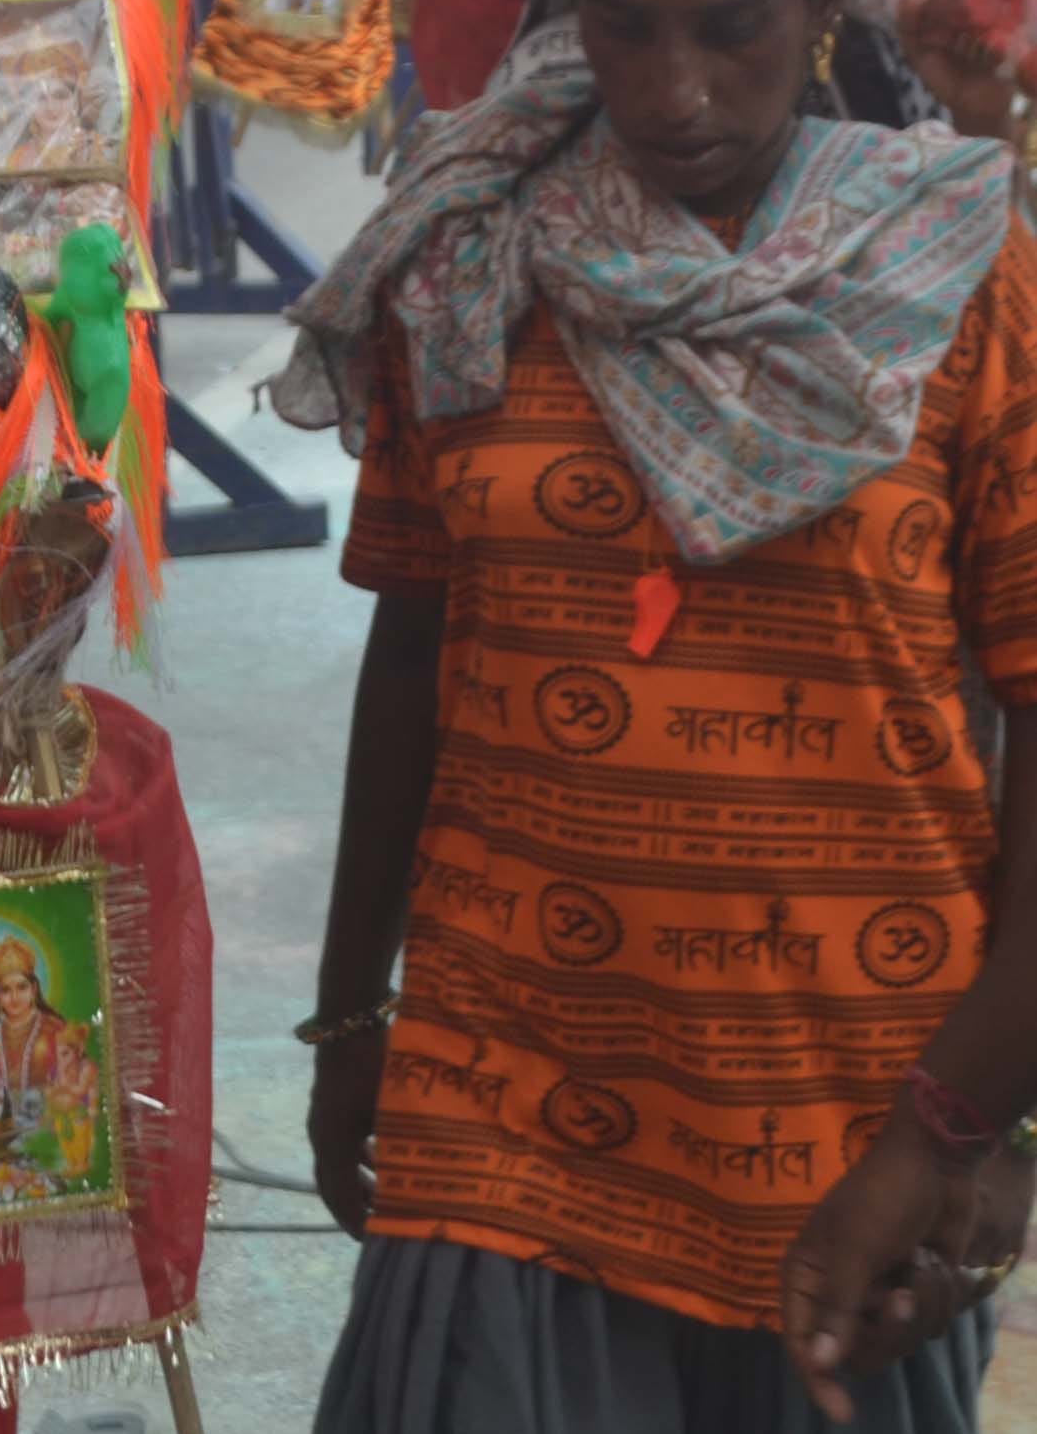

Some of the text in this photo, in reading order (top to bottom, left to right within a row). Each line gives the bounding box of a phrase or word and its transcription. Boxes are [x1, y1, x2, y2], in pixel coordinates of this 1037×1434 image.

[665, 679, 846, 763] महाकाल
[653, 893, 826, 975] महाकाल
[665, 1107, 819, 1187] महाकाल
